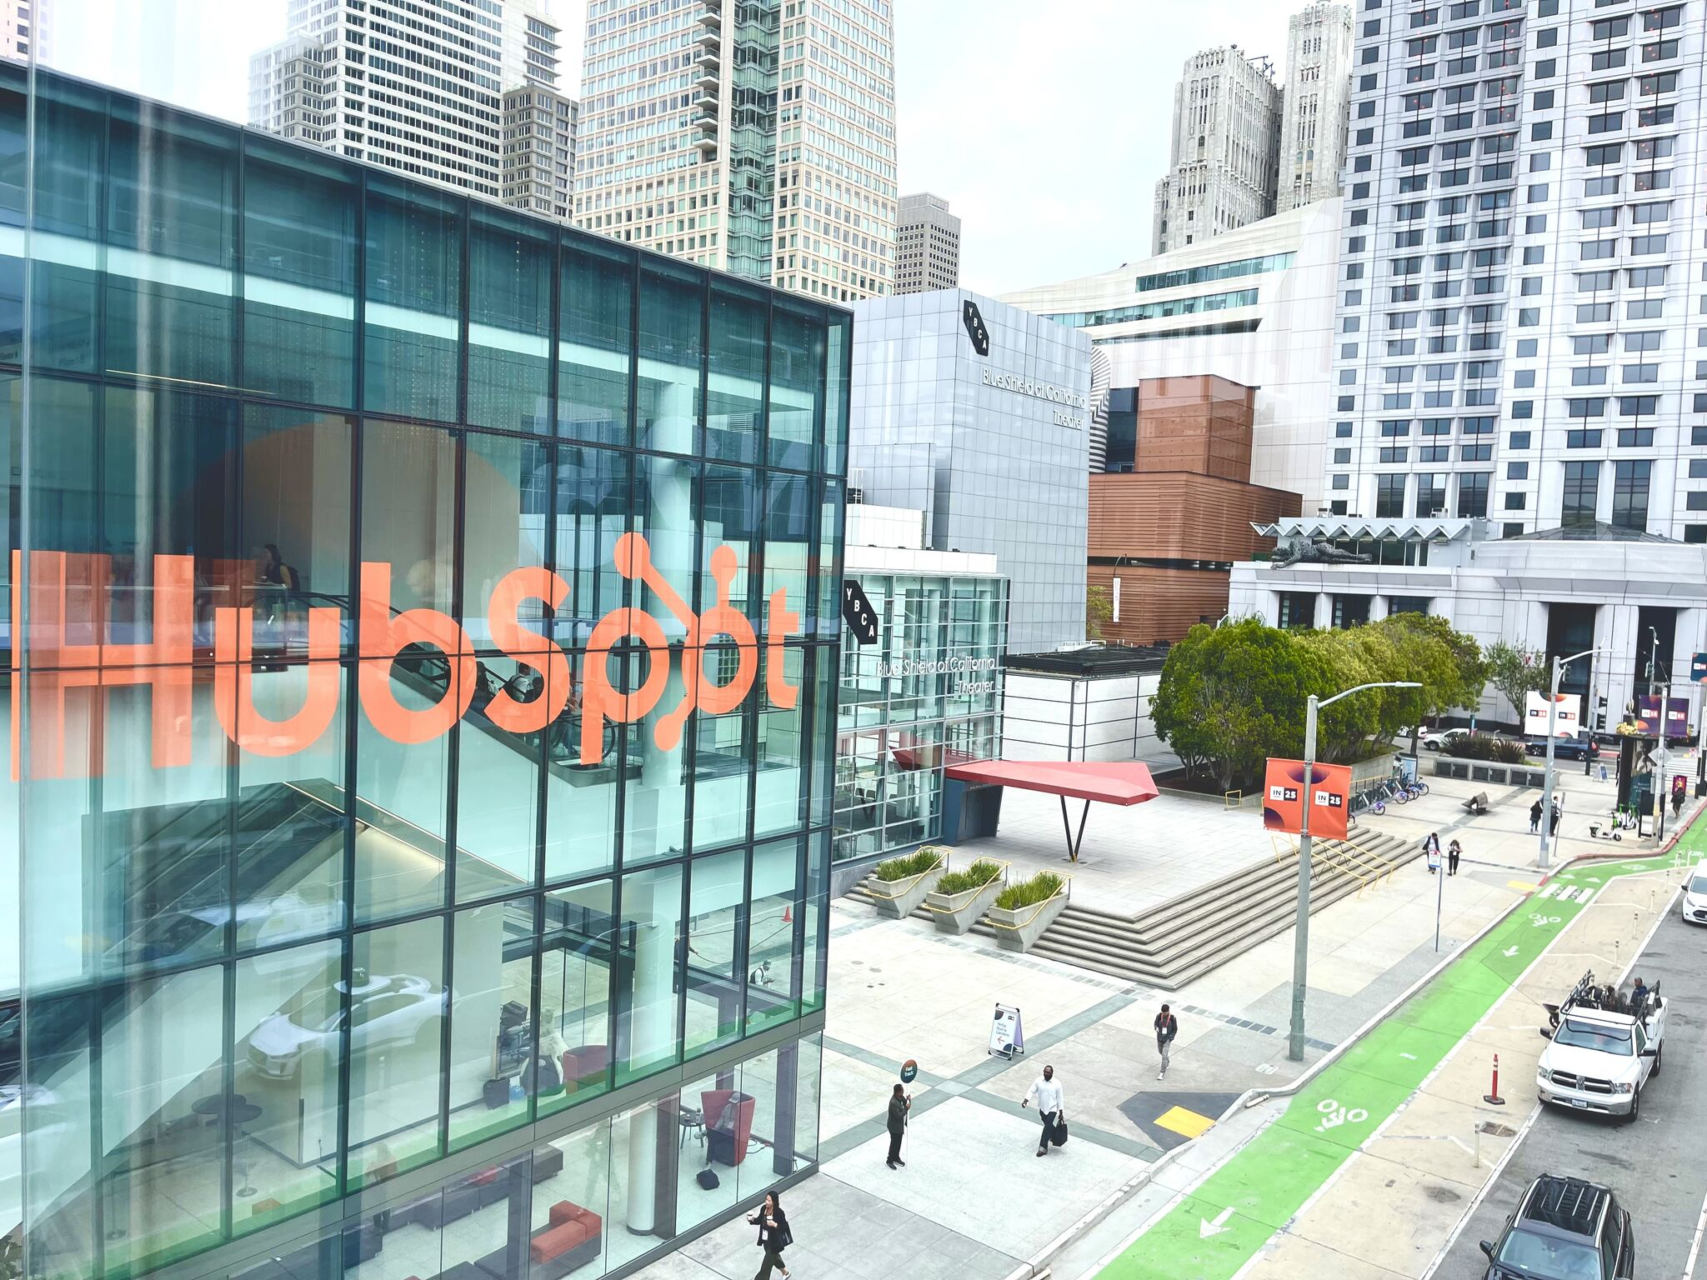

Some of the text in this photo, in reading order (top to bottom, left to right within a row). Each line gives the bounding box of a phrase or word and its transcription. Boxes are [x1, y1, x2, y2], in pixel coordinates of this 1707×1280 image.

[968, 306, 988, 350] YBCA
[983, 368, 1087, 409] Blue Shield of California
[1053, 409, 1085, 430] Theater
[846, 587, 875, 637] YBCA
[11, 531, 800, 781] HubSpot
[876, 655, 996, 677] Blue Shield of California
[959, 679, 995, 694] Theater
[1284, 790, 1296, 798] 25
[1329, 797, 1341, 805] 25
